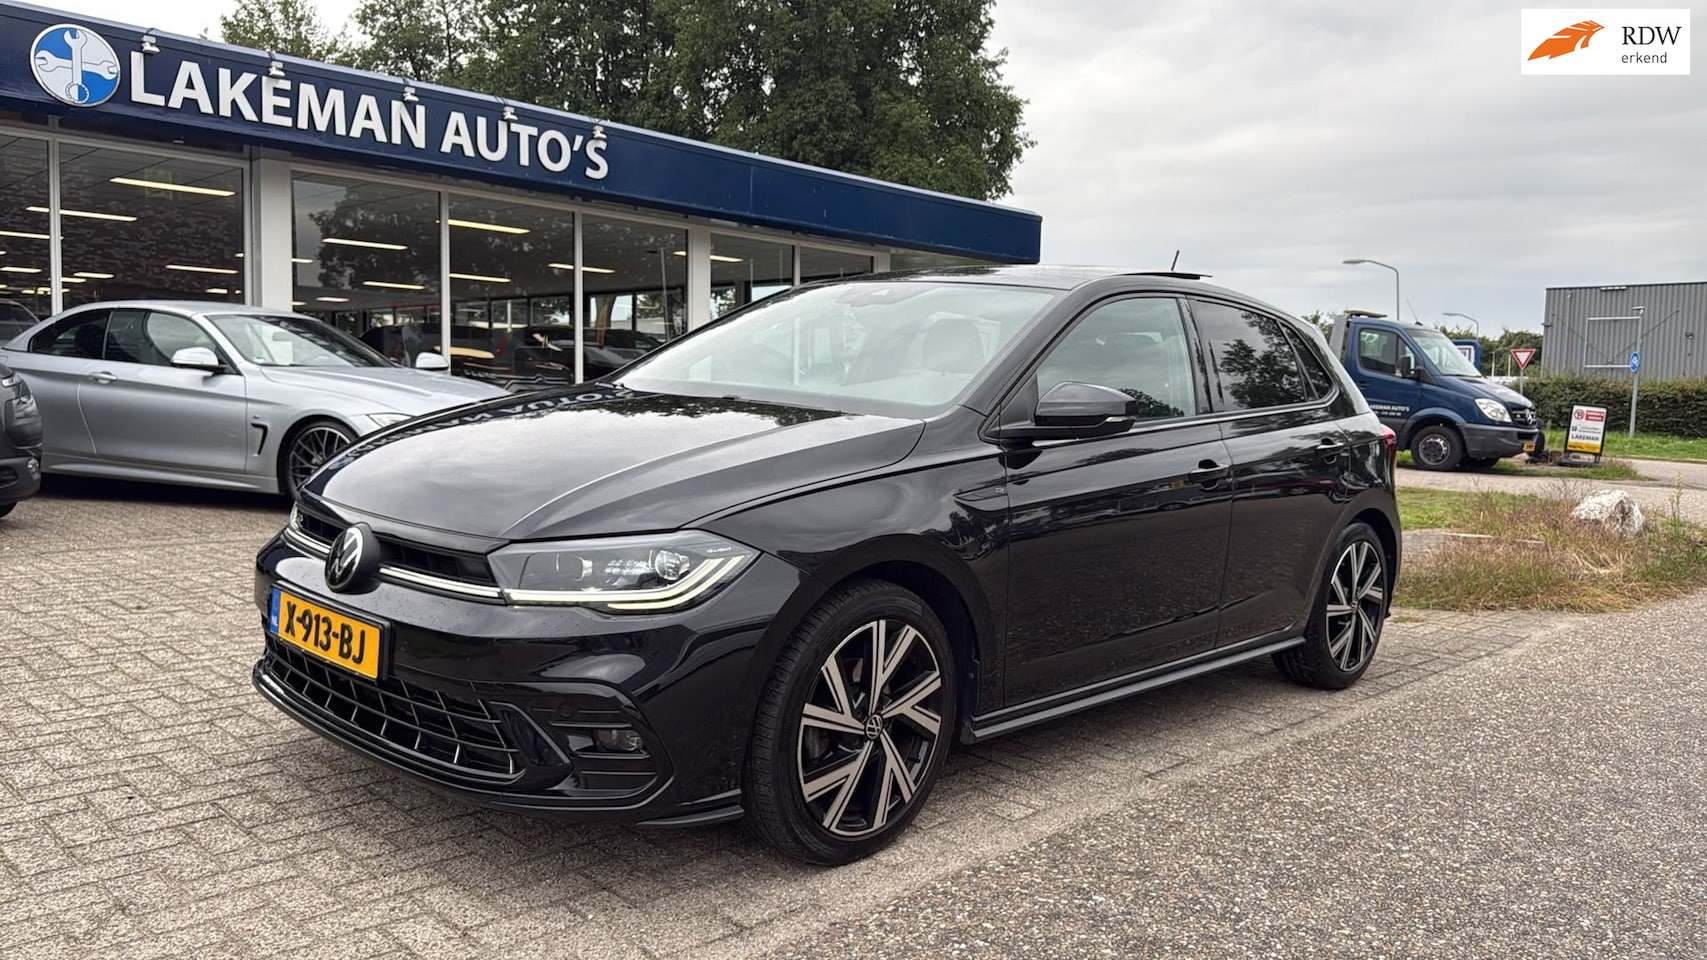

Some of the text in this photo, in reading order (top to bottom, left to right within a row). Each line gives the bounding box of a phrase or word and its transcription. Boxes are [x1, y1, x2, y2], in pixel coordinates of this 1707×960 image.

[130, 49, 610, 181] LAKEMAN AUTO'S
[1571, 434, 1600, 442] LAKEMAN
[284, 600, 366, 665] X-913-BJ
